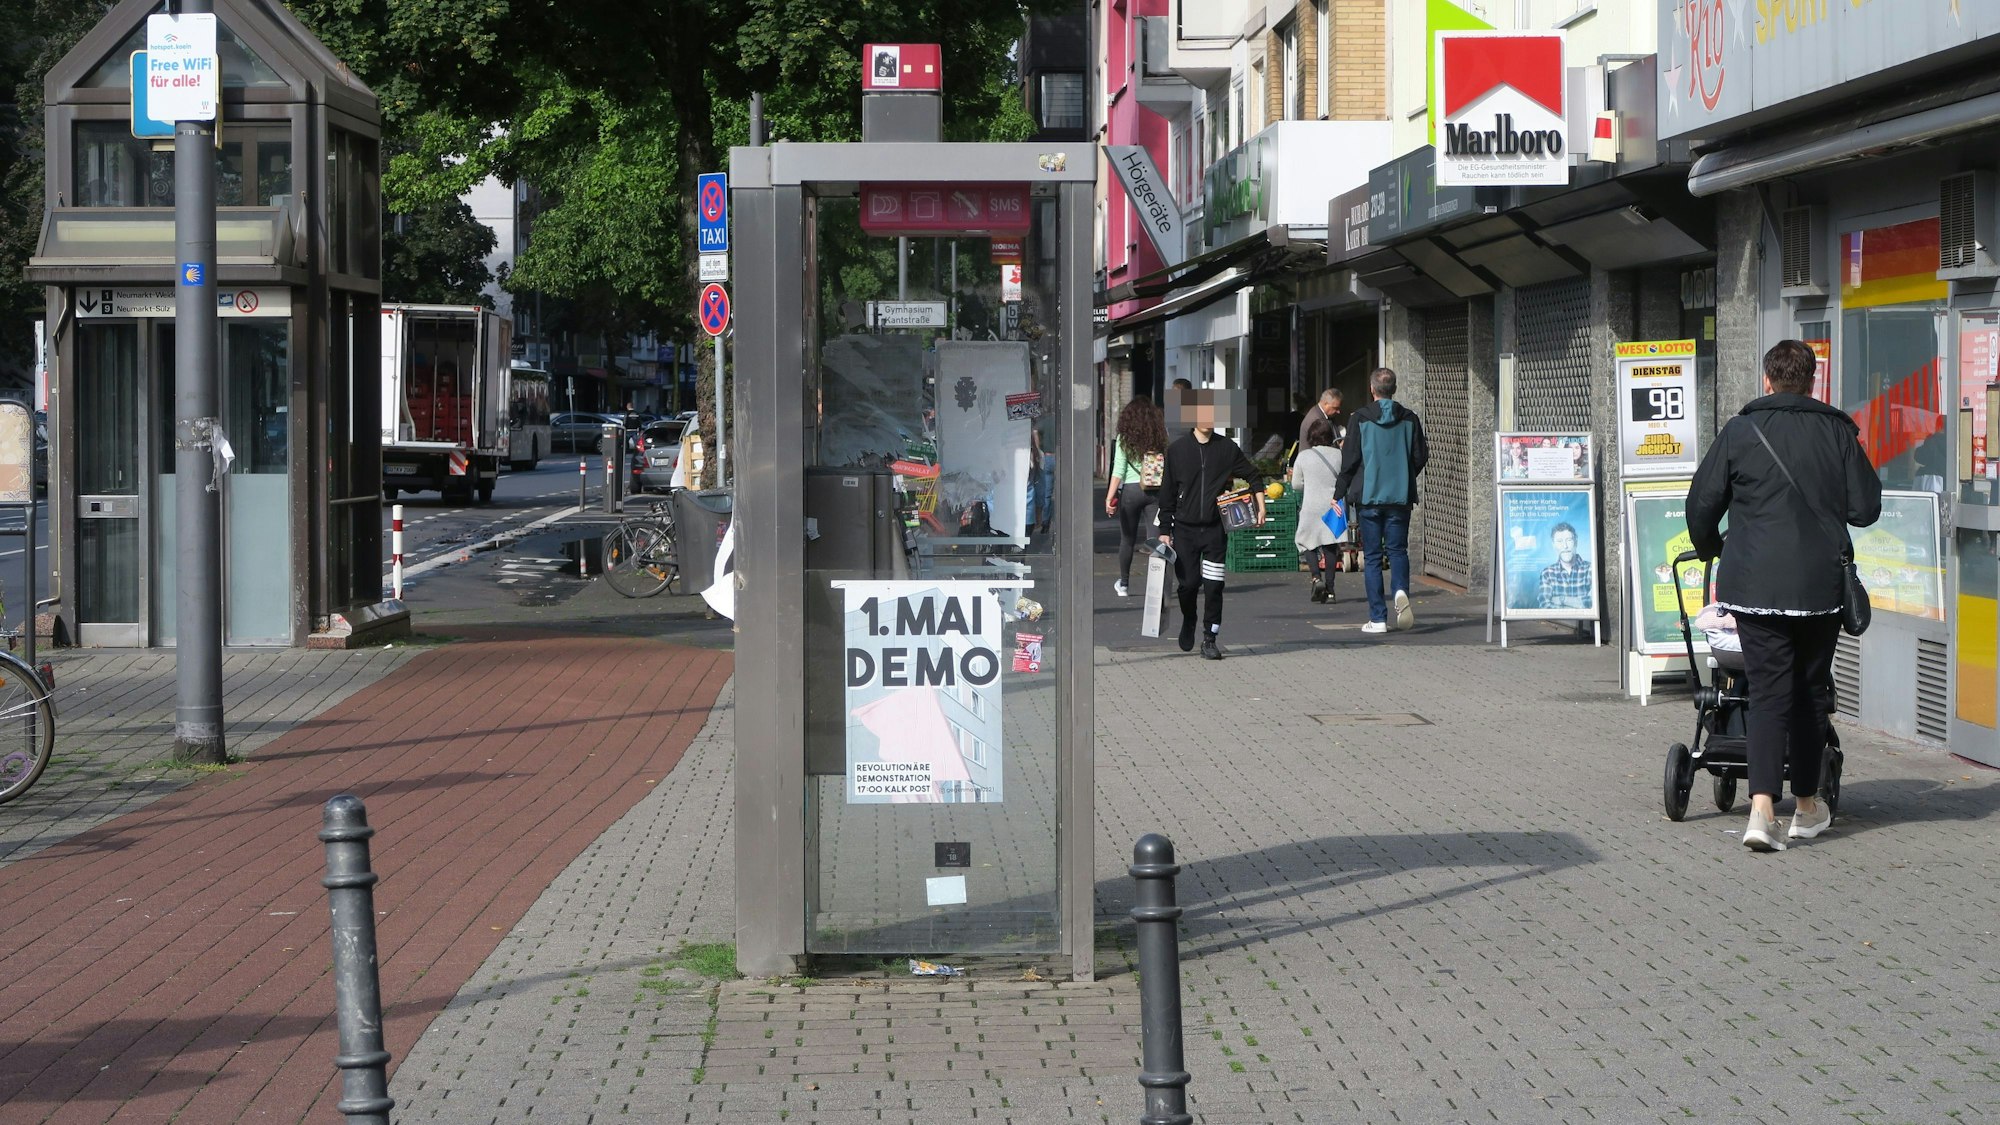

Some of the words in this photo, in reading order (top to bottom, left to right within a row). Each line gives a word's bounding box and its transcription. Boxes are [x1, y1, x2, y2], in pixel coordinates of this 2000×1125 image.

[151, 59, 179, 71] Free
[183, 58, 211, 70] WiFi
[151, 76, 168, 87] für
[172, 74, 200, 87] alle!
[1445, 113, 1562, 155] Marlboro
[1508, 171, 1529, 179] tödlich
[1122, 151, 1171, 234] Hörgeräte
[990, 198, 1020, 211] SMS
[701, 228, 724, 244] TAXI
[104, 292, 110, 300] 1
[104, 305, 111, 313] 9
[116, 304, 170, 313] Neumarkt-Sülz
[884, 305, 933, 314] Gymnasium
[884, 315, 931, 324] Kantstraße
[1617, 344, 1648, 355] WEST
[1659, 342, 1694, 353] LOTTO
[1632, 366, 1681, 376] DIENSTAG
[1648, 388, 1684, 419] 98
[1636, 443, 1680, 456] JACKPOT
[1679, 536, 1692, 544] Vie
[1672, 545, 1696, 553] Chan
[847, 647, 999, 687] DEMO
[857, 762, 930, 772] REVOLUTIONÄRE
[858, 785, 883, 793] 17:00
[885, 785, 907, 793] KALK
[910, 785, 931, 793] POST
